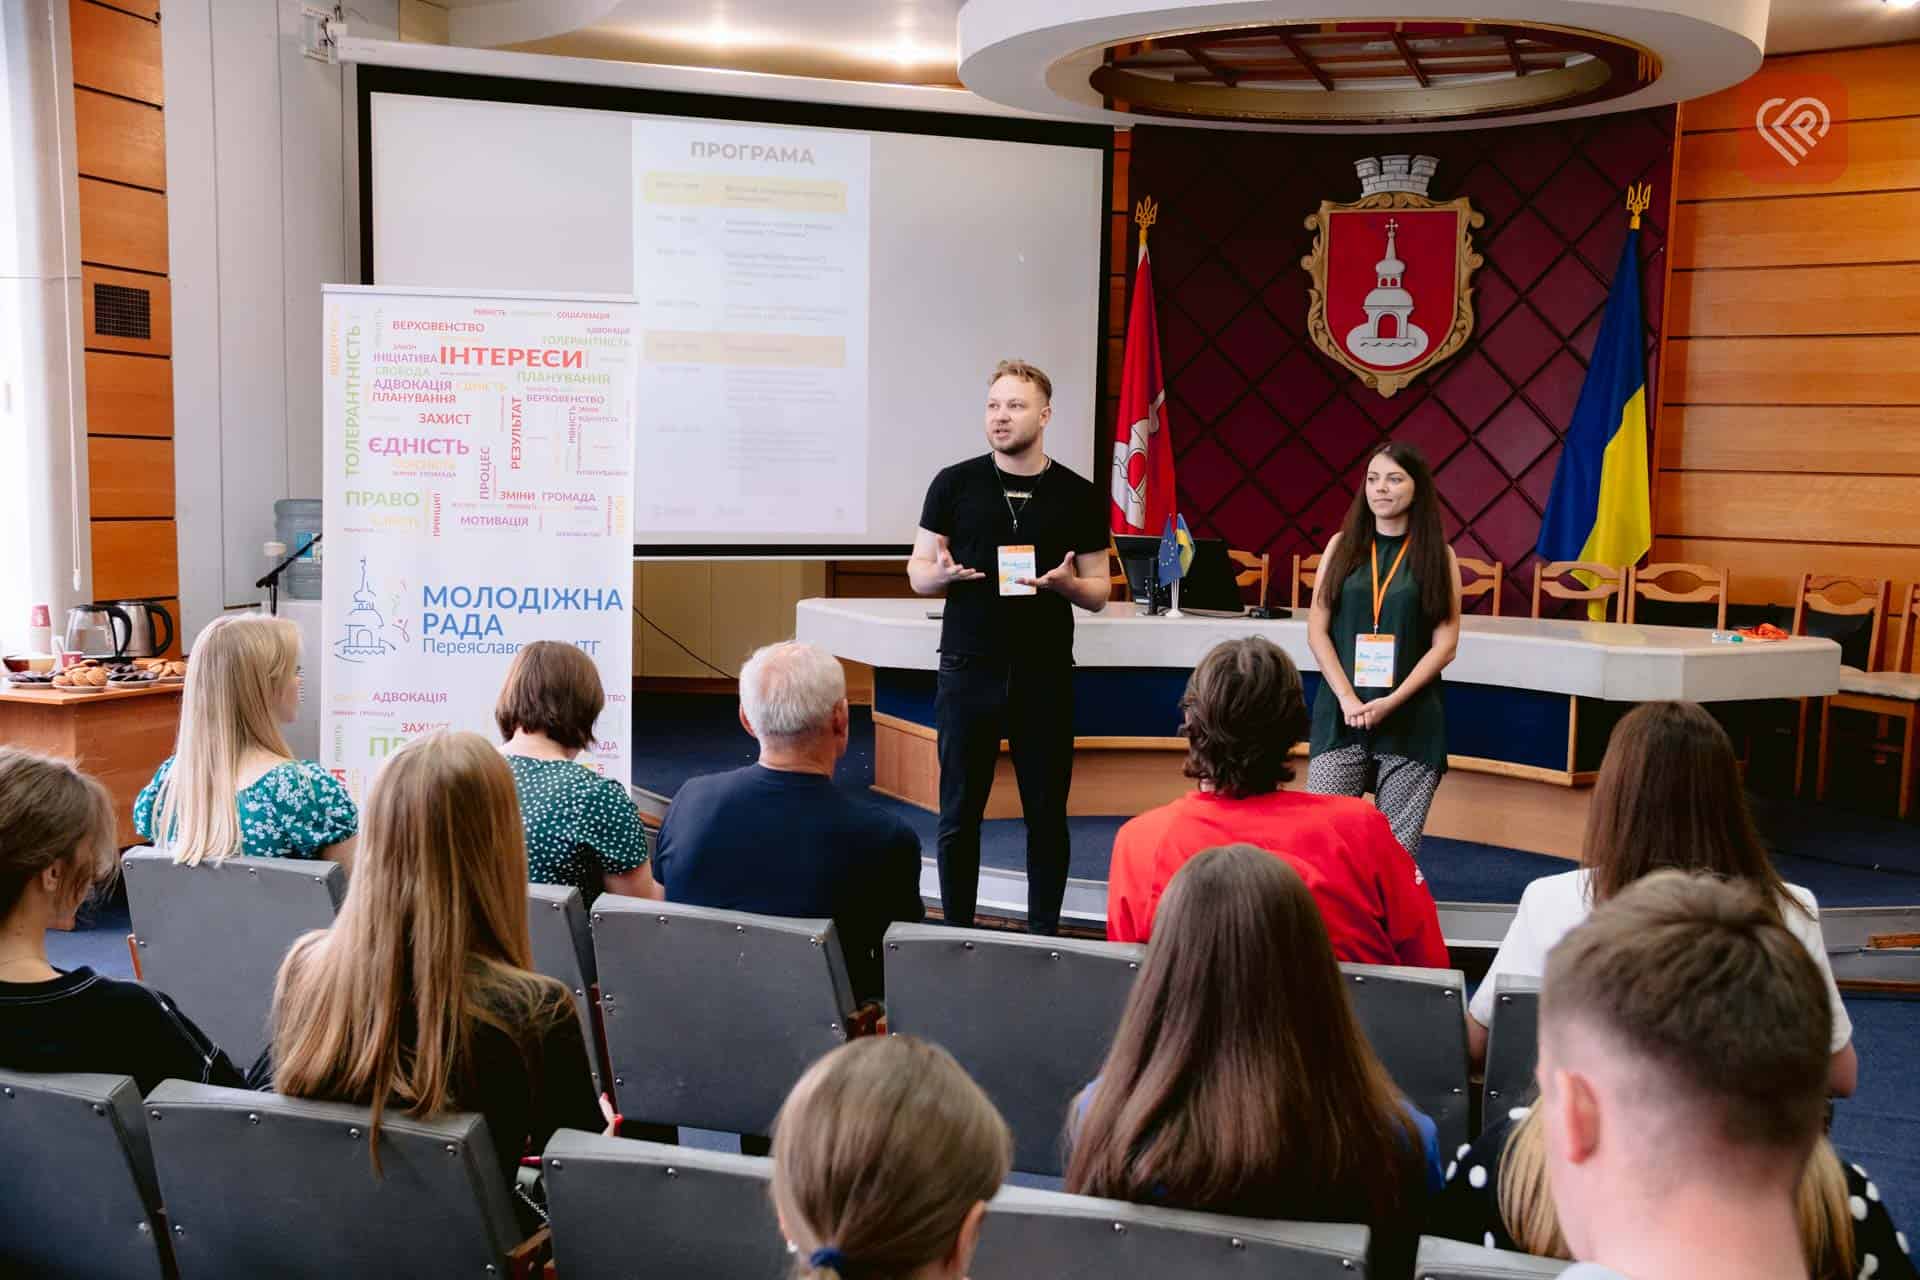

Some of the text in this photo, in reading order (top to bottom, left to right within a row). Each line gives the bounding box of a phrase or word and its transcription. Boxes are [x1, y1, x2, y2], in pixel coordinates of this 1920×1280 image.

[691, 141, 815, 164] ПРОГРАМА
[392, 321, 485, 333] ВЕРХОВЕНСТВО
[373, 353, 438, 364] ІНІЦІАТИВА
[440, 346, 583, 369] ІНТЕРЕСИ
[374, 378, 452, 392] АДВОКАЦІЯ
[517, 371, 611, 385] ПЛАНУВАННЯ
[345, 325, 361, 478] ТОЛЕРАНТНІСТЬ
[372, 392, 457, 404] ПЛАНУВАННЯ
[526, 394, 605, 404] ВЕРХОВЕНСТВО
[418, 413, 472, 425] ЗАХИСТ
[511, 397, 522, 469] РЕЗУЛЬТАТ
[368, 437, 470, 456] ЄДНІСТЬ
[480, 447, 491, 500] ПРОЦЕС
[345, 490, 420, 508] ПРАВО
[500, 491, 597, 503] ЗМІНИ ГРОМАДА
[432, 492, 441, 537] ПРИНЦИП
[460, 515, 529, 527] МОТИВАЦІЯ
[423, 585, 624, 614] МОЛОДІЖНА
[423, 613, 504, 640] РАДА
[372, 692, 448, 704] АДВОКАЦІЯ
